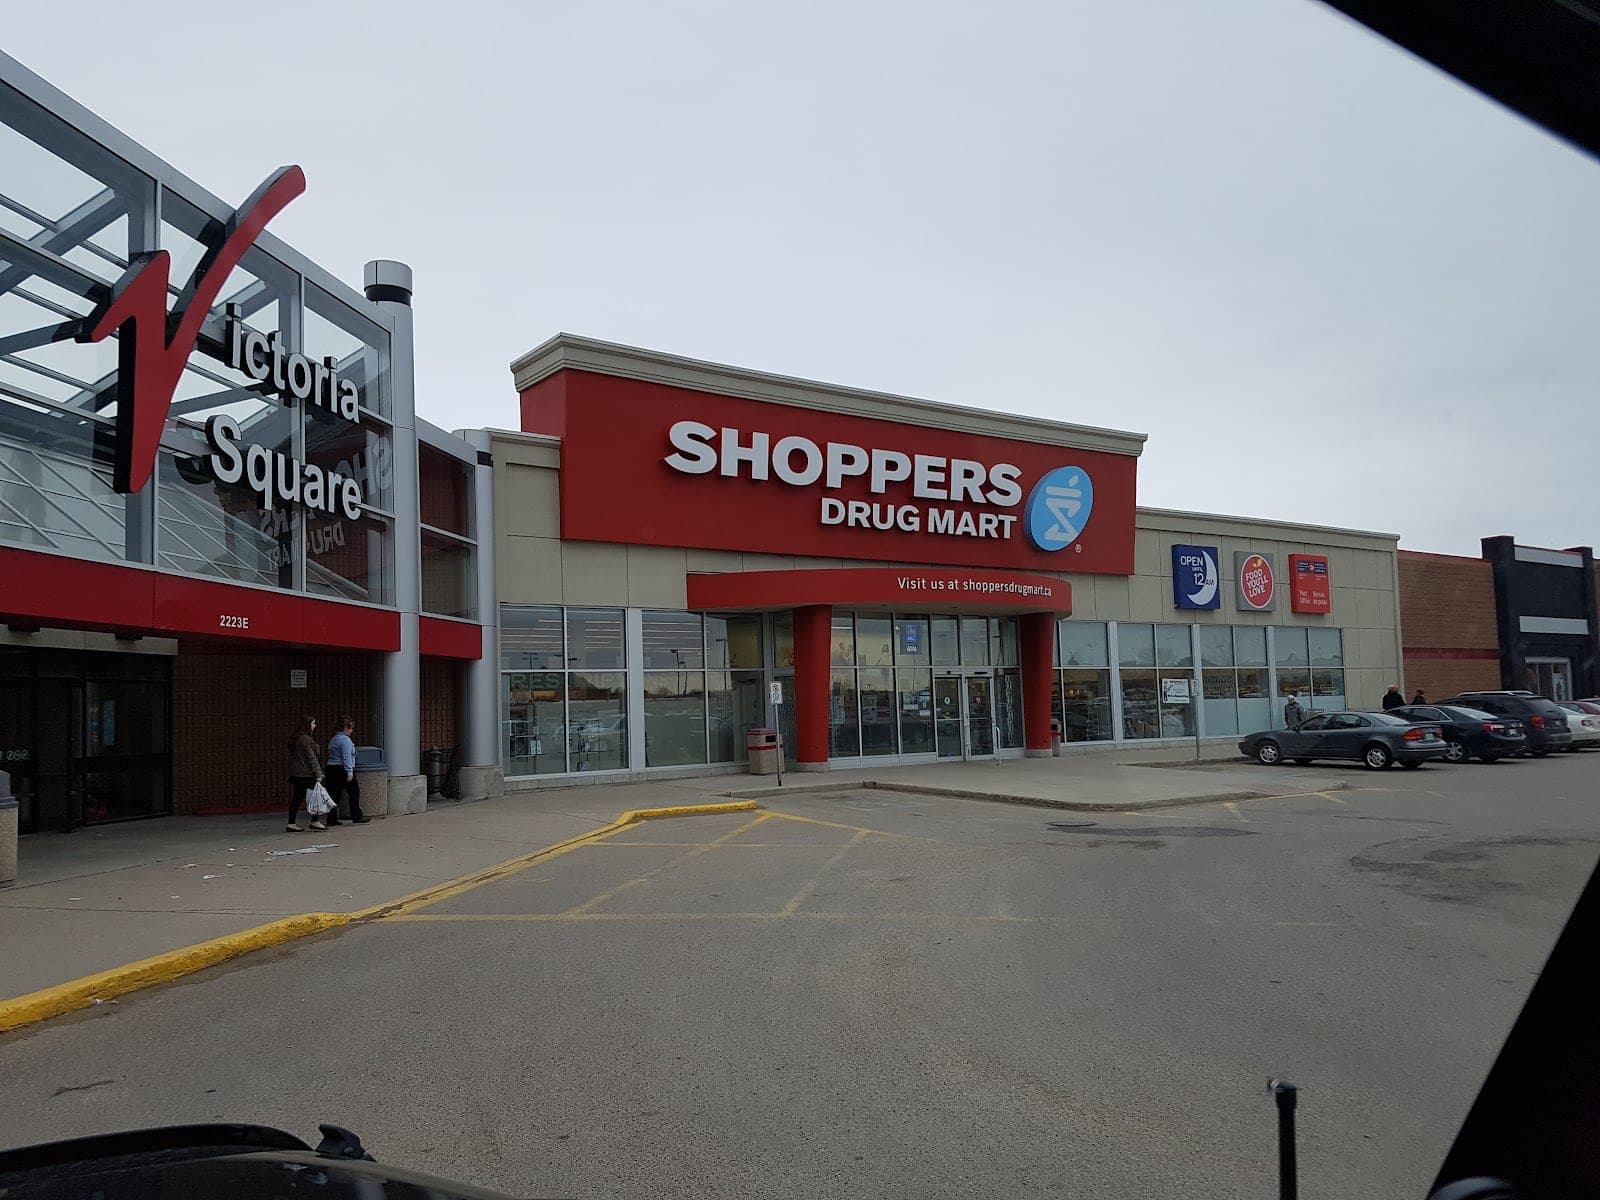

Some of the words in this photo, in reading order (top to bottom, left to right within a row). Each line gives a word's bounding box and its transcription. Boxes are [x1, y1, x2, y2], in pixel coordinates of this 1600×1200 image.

[80, 165, 362, 494] Victoria
[205, 414, 363, 521] Square
[664, 420, 1023, 508] SHOPPERS
[820, 497, 921, 533] DRUG
[927, 507, 1017, 540] MART
[1180, 555, 1204, 568] OPEN
[1193, 572, 1205, 587] 12
[1205, 578, 1215, 586] AM
[1245, 568, 1263, 583] FOOD
[1246, 576, 1270, 589] YOU'LL
[897, 577, 926, 590] Visit
[930, 580, 945, 590] us
[947, 579, 960, 591] at
[962, 579, 1052, 597] shoppersdrugmart.ca
[1249, 585, 1266, 598] LOVE
[219, 614, 249, 630] 2223E
